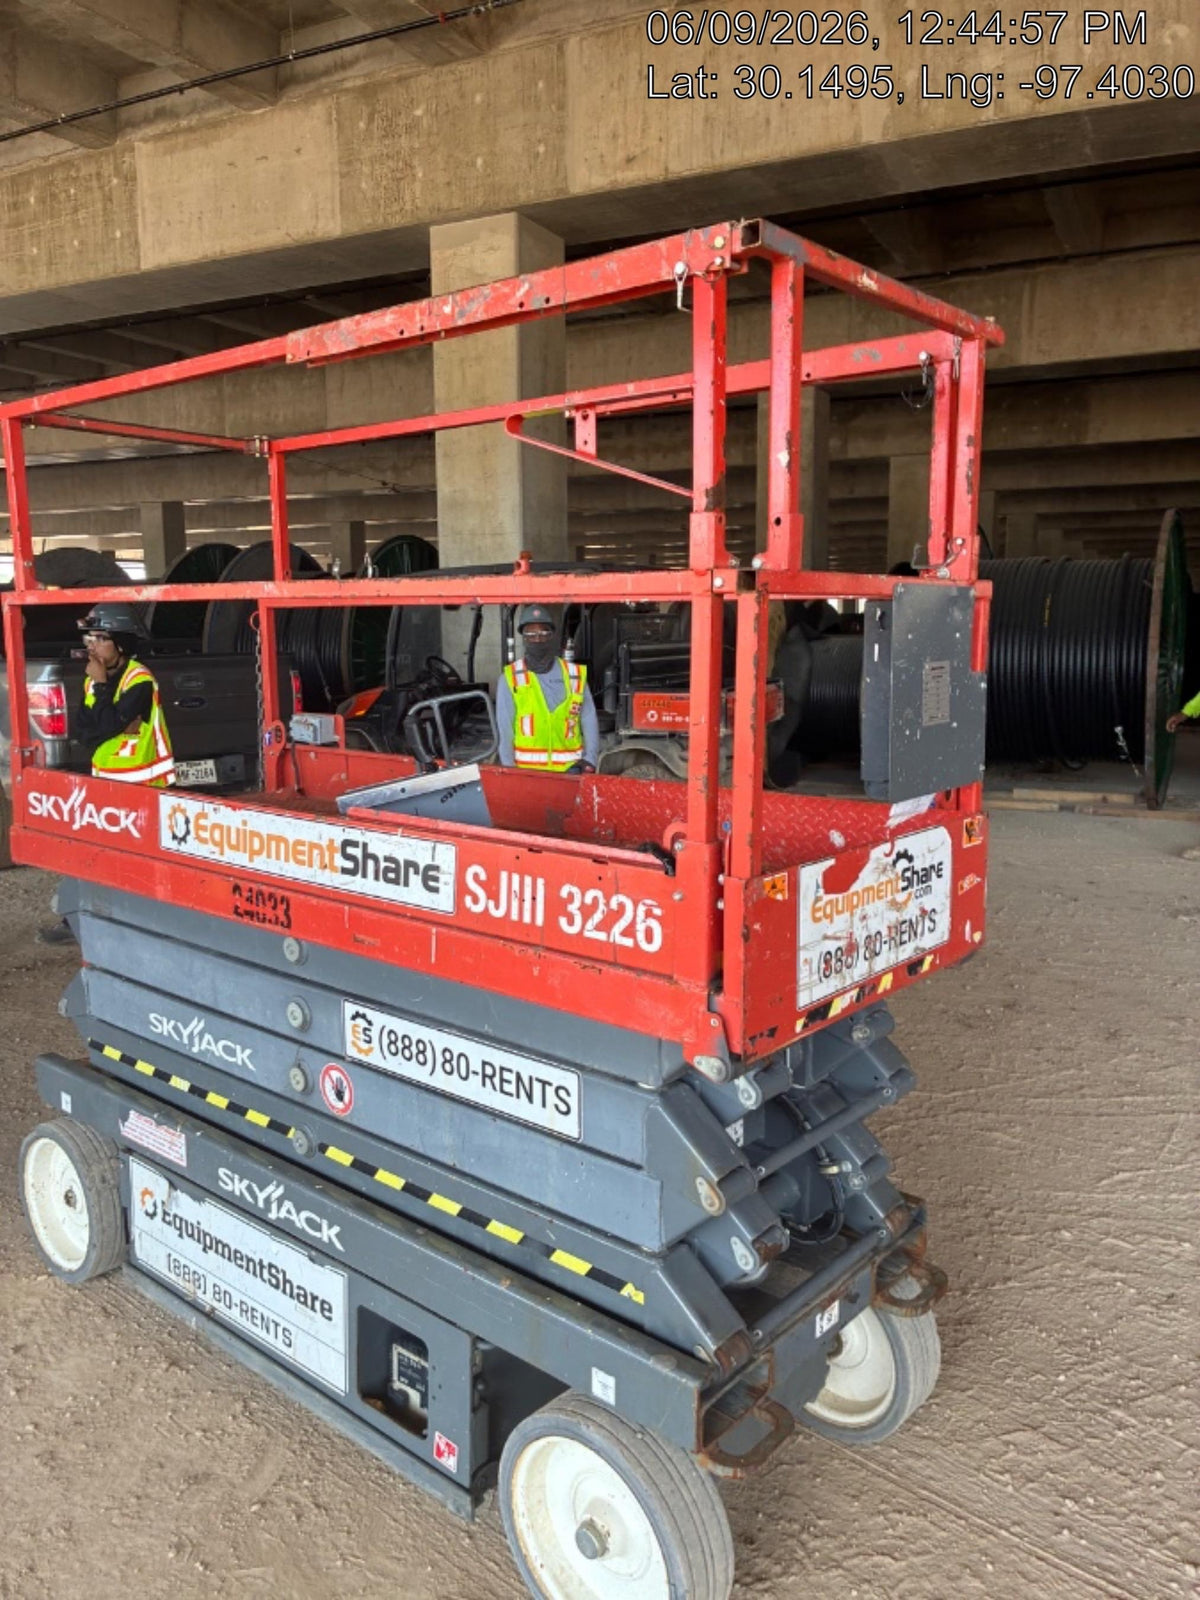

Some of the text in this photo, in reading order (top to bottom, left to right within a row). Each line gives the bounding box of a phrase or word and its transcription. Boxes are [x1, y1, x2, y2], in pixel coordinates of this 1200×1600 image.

[28, 785, 141, 838] SKYJACK
[193, 809, 440, 893] EquipmentShare
[464, 864, 663, 953] SJIII 3226
[810, 861, 943, 924] EquipmentShare
[149, 1012, 256, 1072] SKYJACK
[218, 1167, 345, 1252] SKYJACK
[161, 1199, 334, 1322] EquipmentShare
[167, 1252, 293, 1349] (888) 80-RENTS
